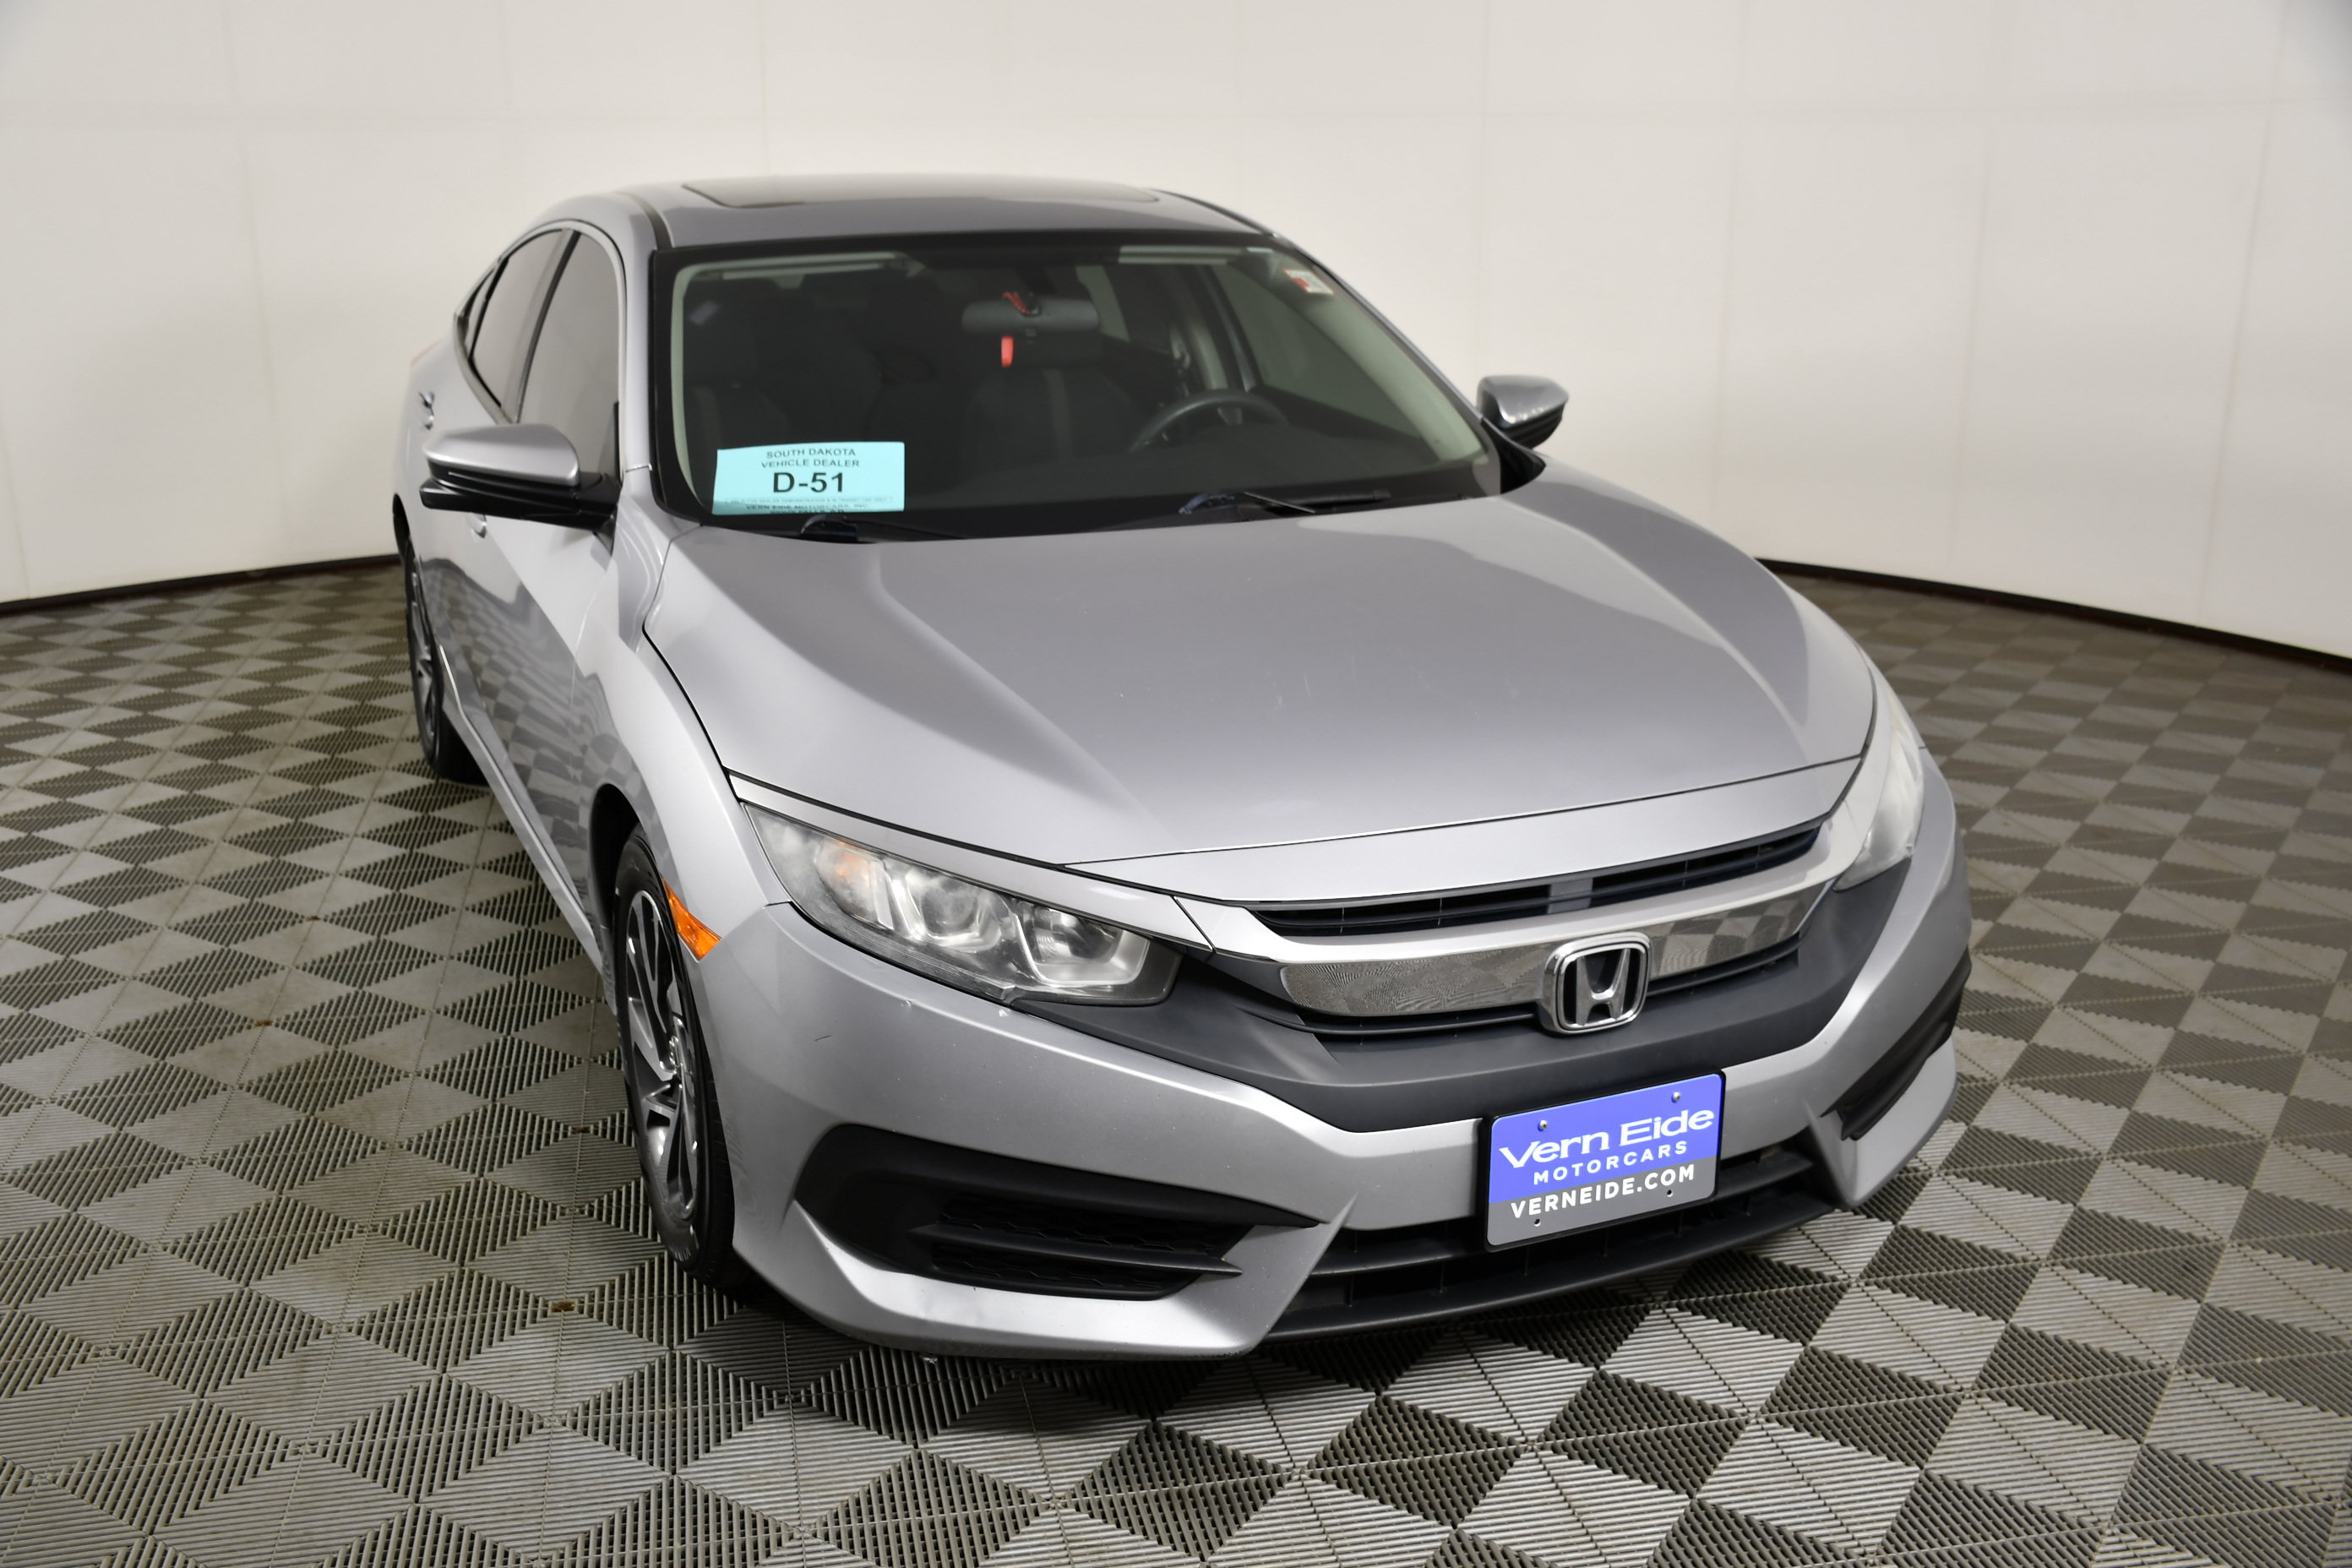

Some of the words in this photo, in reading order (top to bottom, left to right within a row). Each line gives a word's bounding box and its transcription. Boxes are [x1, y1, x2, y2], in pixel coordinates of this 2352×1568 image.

[761, 459, 804, 468] VEHICLE
[766, 449, 804, 458] SOUTH
[808, 448, 856, 456] DAKOTA
[773, 472, 843, 493] D-51
[1499, 1131, 1609, 1168] Vern
[1620, 1109, 1715, 1146] Eide
[1533, 1141, 1687, 1185] MOTORCARS
[1511, 1164, 1695, 1218] VERNEIDE.COM
